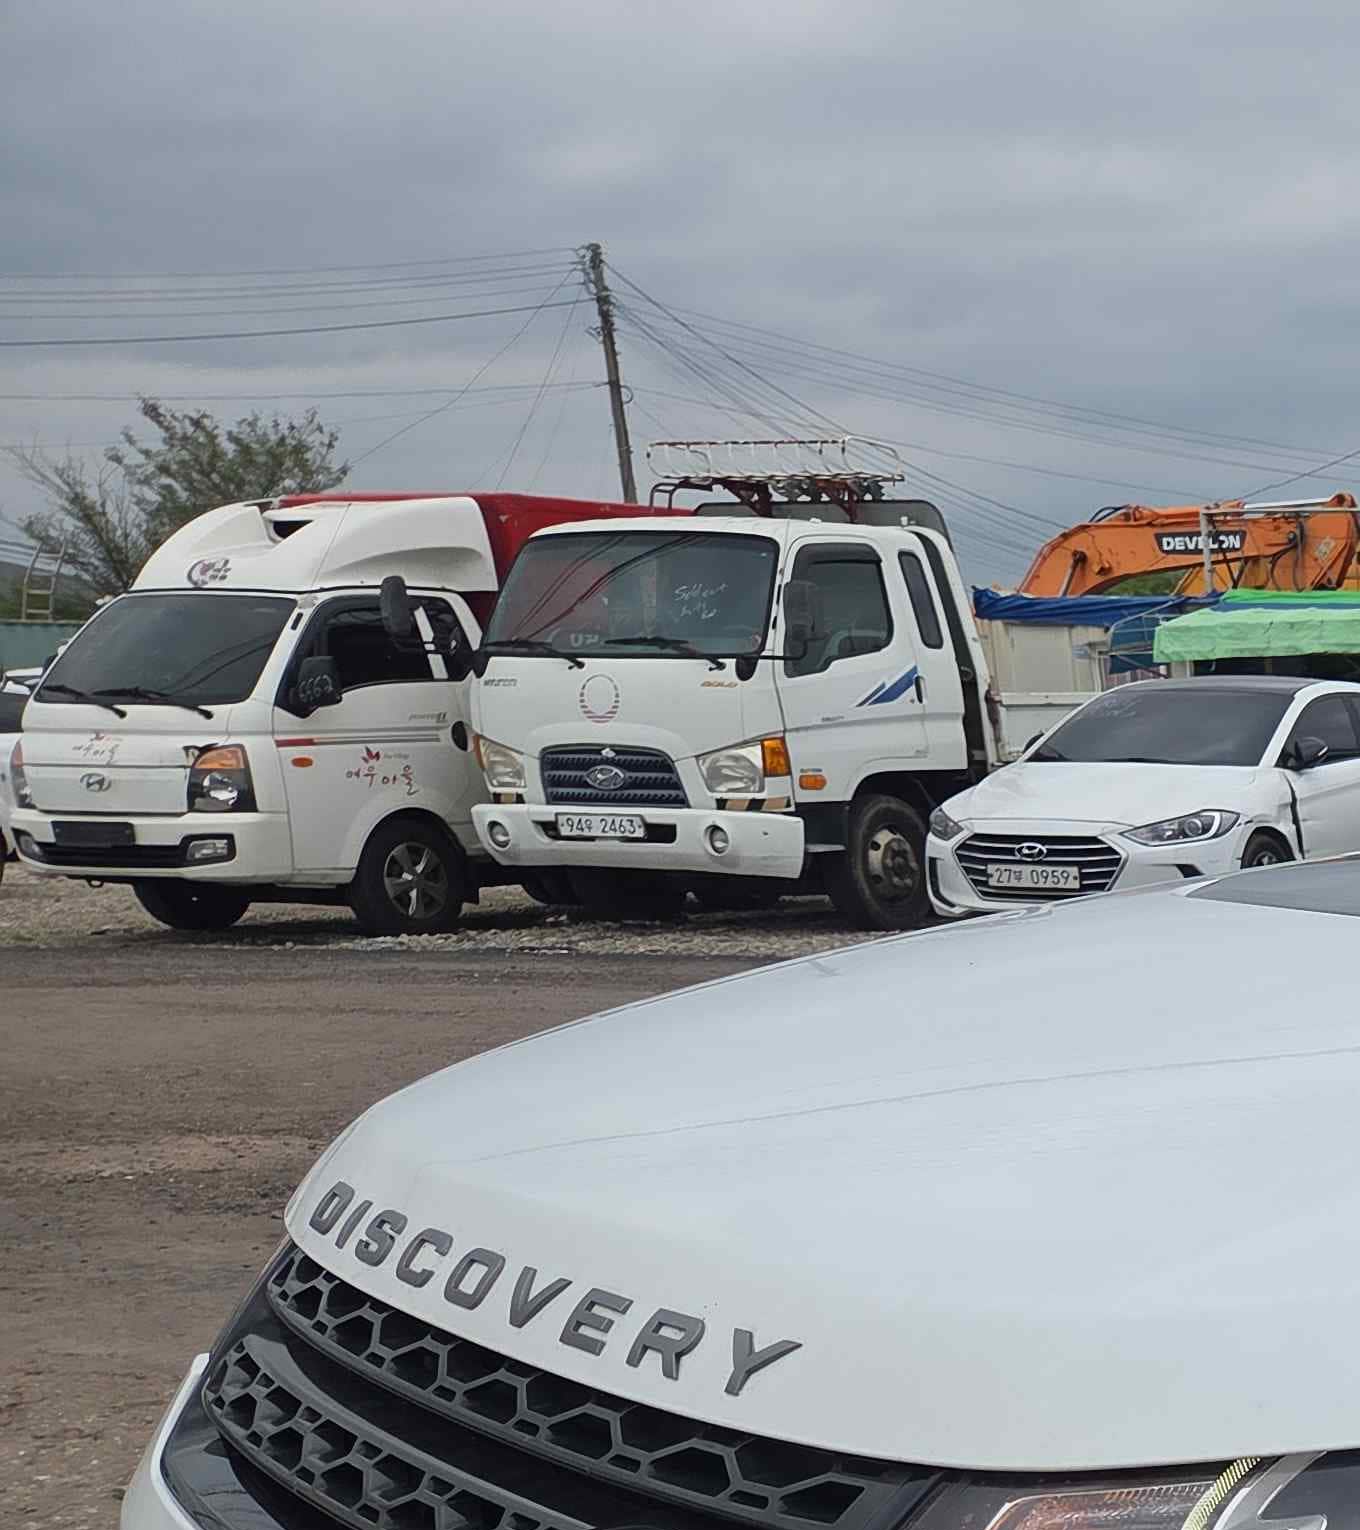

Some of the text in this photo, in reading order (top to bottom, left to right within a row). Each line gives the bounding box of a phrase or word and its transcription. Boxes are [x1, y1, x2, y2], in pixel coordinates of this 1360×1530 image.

[599, 817, 637, 835] 2463
[1030, 868, 1070, 886] 0959
[308, 1180, 803, 1397] DISCOVERY
